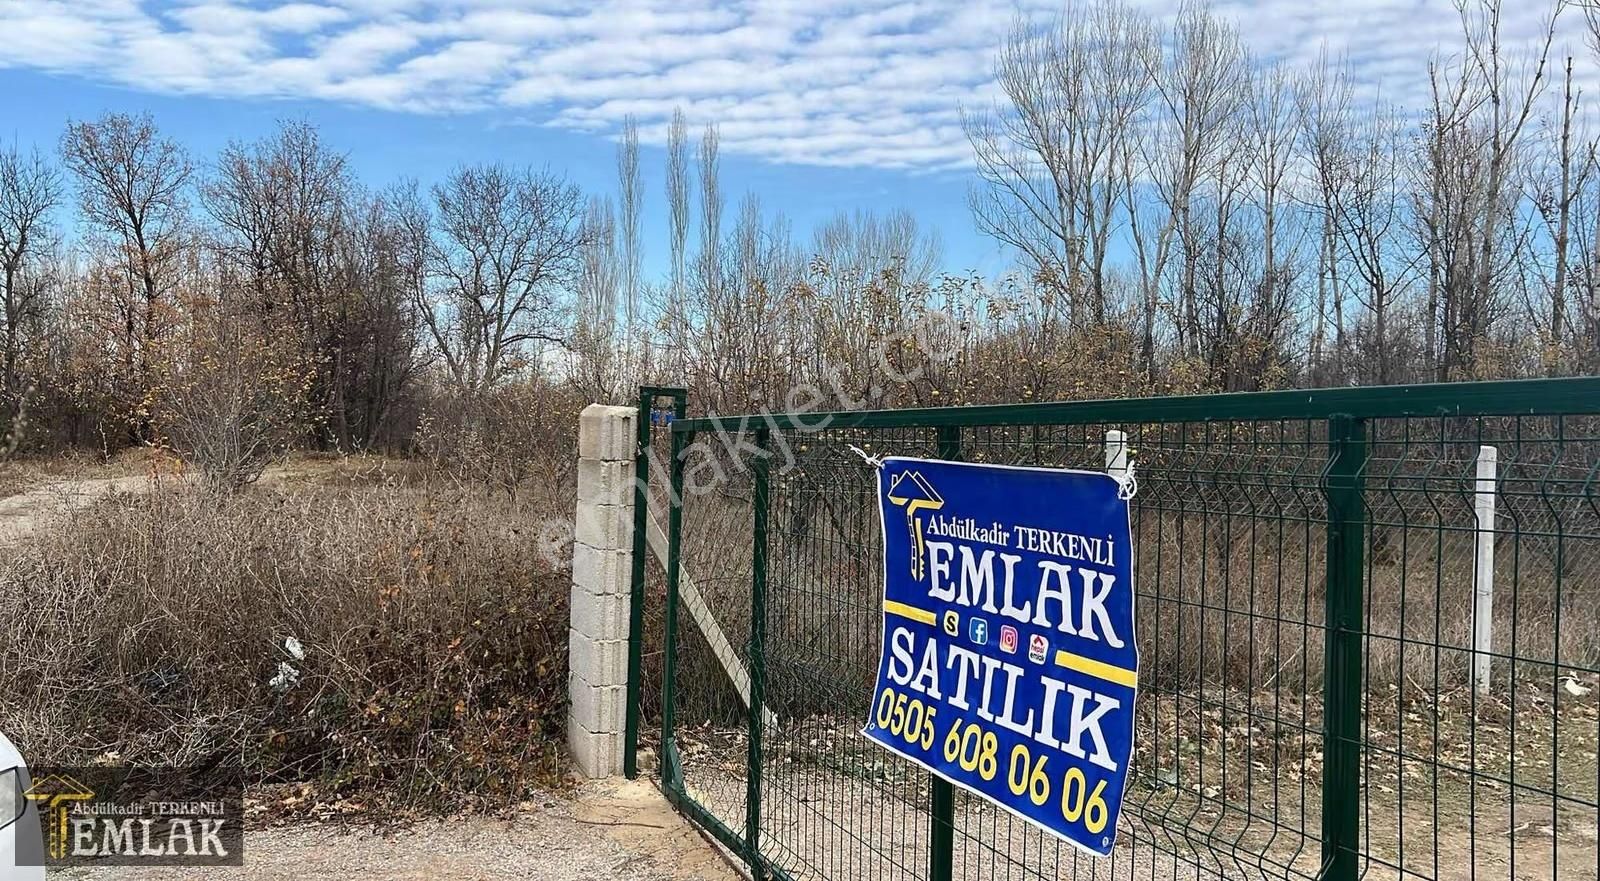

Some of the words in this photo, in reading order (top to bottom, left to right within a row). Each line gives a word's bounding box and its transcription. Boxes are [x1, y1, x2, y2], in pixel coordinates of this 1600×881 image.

[925, 540, 1125, 648] EMLAK
[926, 514, 1010, 547] Abdülkadir
[1013, 526, 1115, 567] TERKENLİ
[876, 687, 937, 751] 0505
[943, 718, 998, 781] 608
[1008, 743, 1050, 806] 06
[1061, 767, 1109, 834] 06
[887, 626, 1120, 772] SATILIK
